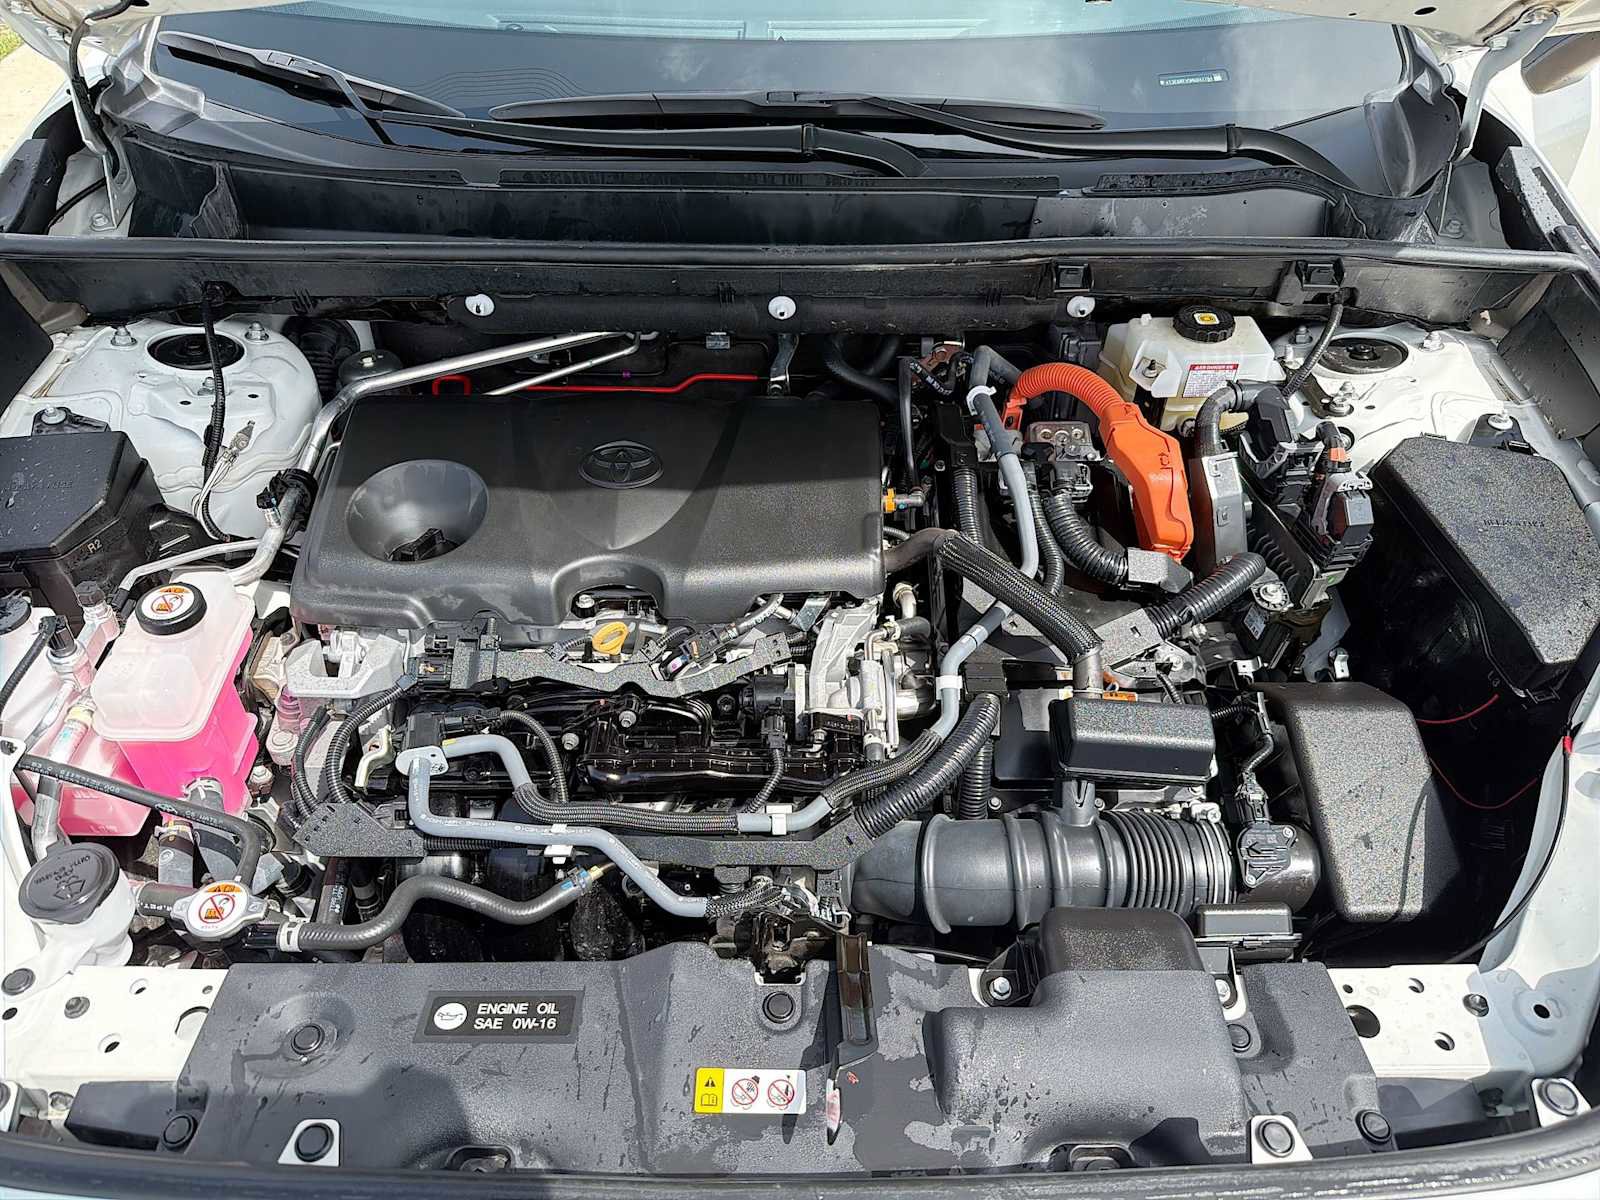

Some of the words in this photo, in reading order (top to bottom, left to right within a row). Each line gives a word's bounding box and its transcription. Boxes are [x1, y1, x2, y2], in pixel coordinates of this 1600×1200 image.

[87, 539, 102, 553] R2
[476, 1003, 529, 1014] ENGINE
[536, 1003, 559, 1014] OIL
[473, 1018, 503, 1030] SAE
[511, 1018, 557, 1030] 0W-16
